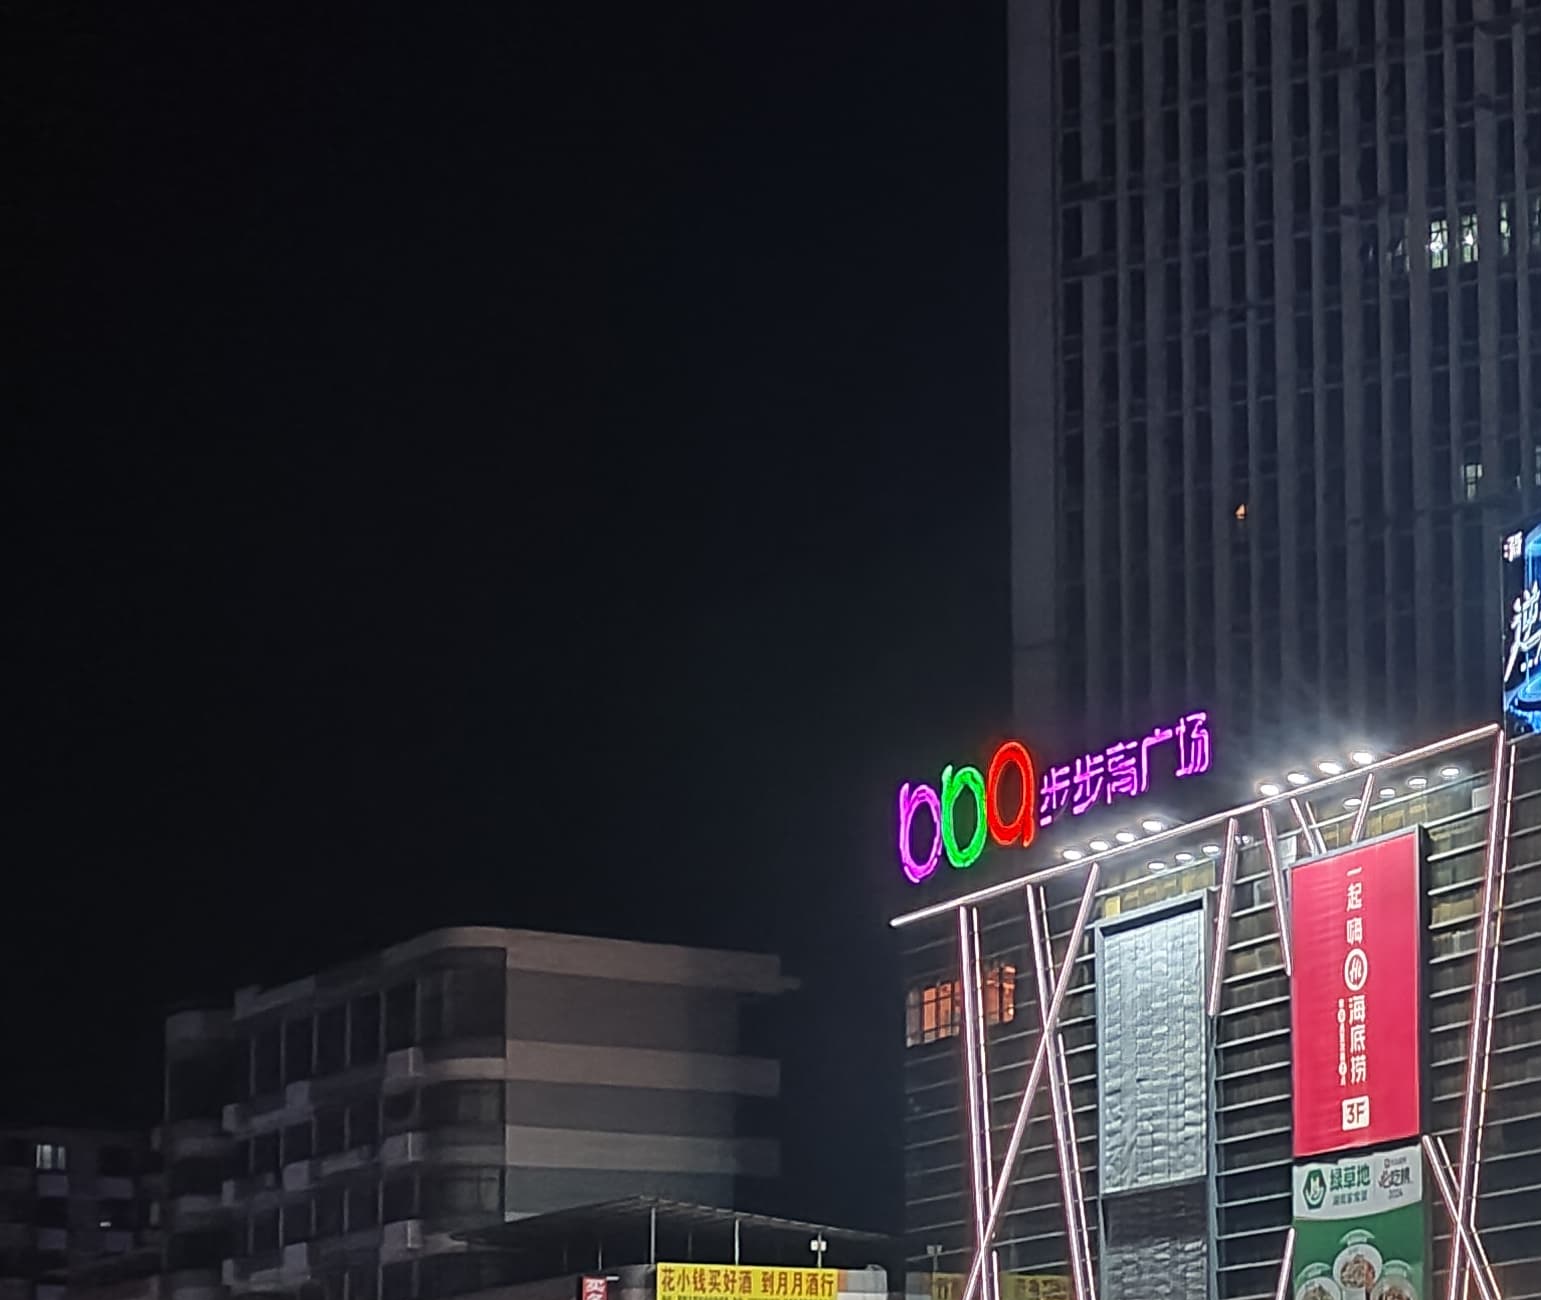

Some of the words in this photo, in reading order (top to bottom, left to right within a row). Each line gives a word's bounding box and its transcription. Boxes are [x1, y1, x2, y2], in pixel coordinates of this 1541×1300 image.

[1040, 711, 1212, 827] 步步高广场
[1348, 994, 1368, 1085] 海底捞
[1345, 1101, 1365, 1125] 3F
[1329, 1163, 1371, 1192] 绿草地
[661, 1266, 753, 1294] 花小钱买好酒
[761, 1270, 835, 1298] 到月月酒行
